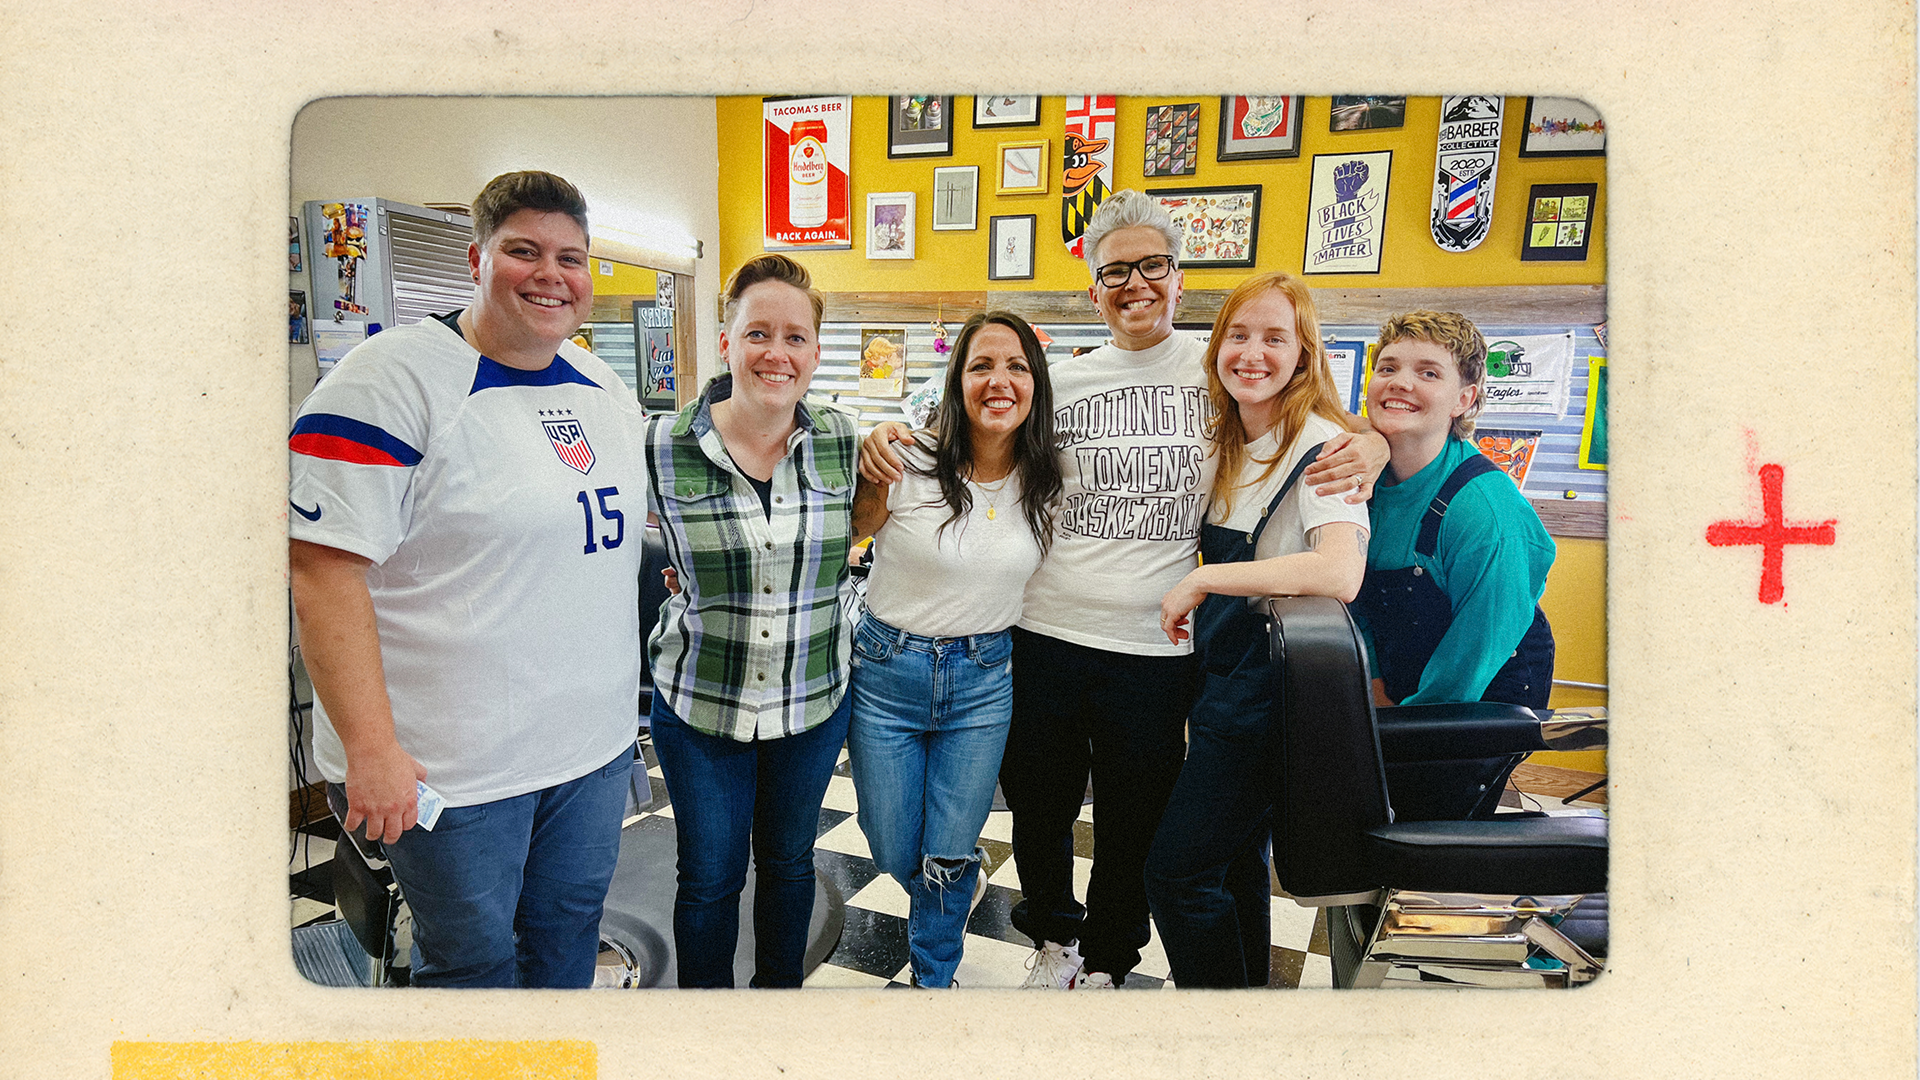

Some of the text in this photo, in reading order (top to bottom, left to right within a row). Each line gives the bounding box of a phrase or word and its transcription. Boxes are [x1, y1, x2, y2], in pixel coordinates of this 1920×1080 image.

[774, 103, 842, 116] TACOMA'S BEER
[1447, 122, 1499, 139] BARBER
[1441, 140, 1495, 151] COLLECTIVE
[793, 161, 824, 173] Heidelberg
[1450, 158, 1485, 171] 2020
[1323, 197, 1367, 223] BLACK
[776, 231, 839, 241] BACK AGAIN.
[1327, 222, 1364, 243] LIVES
[1318, 244, 1366, 260] MATTER
[1055, 385, 1218, 451] ROOTING FO
[547, 424, 581, 445] USA
[1076, 445, 1204, 493] WOMEN'S
[577, 486, 624, 555] 15
[1061, 493, 1206, 541] BASKETBALL
